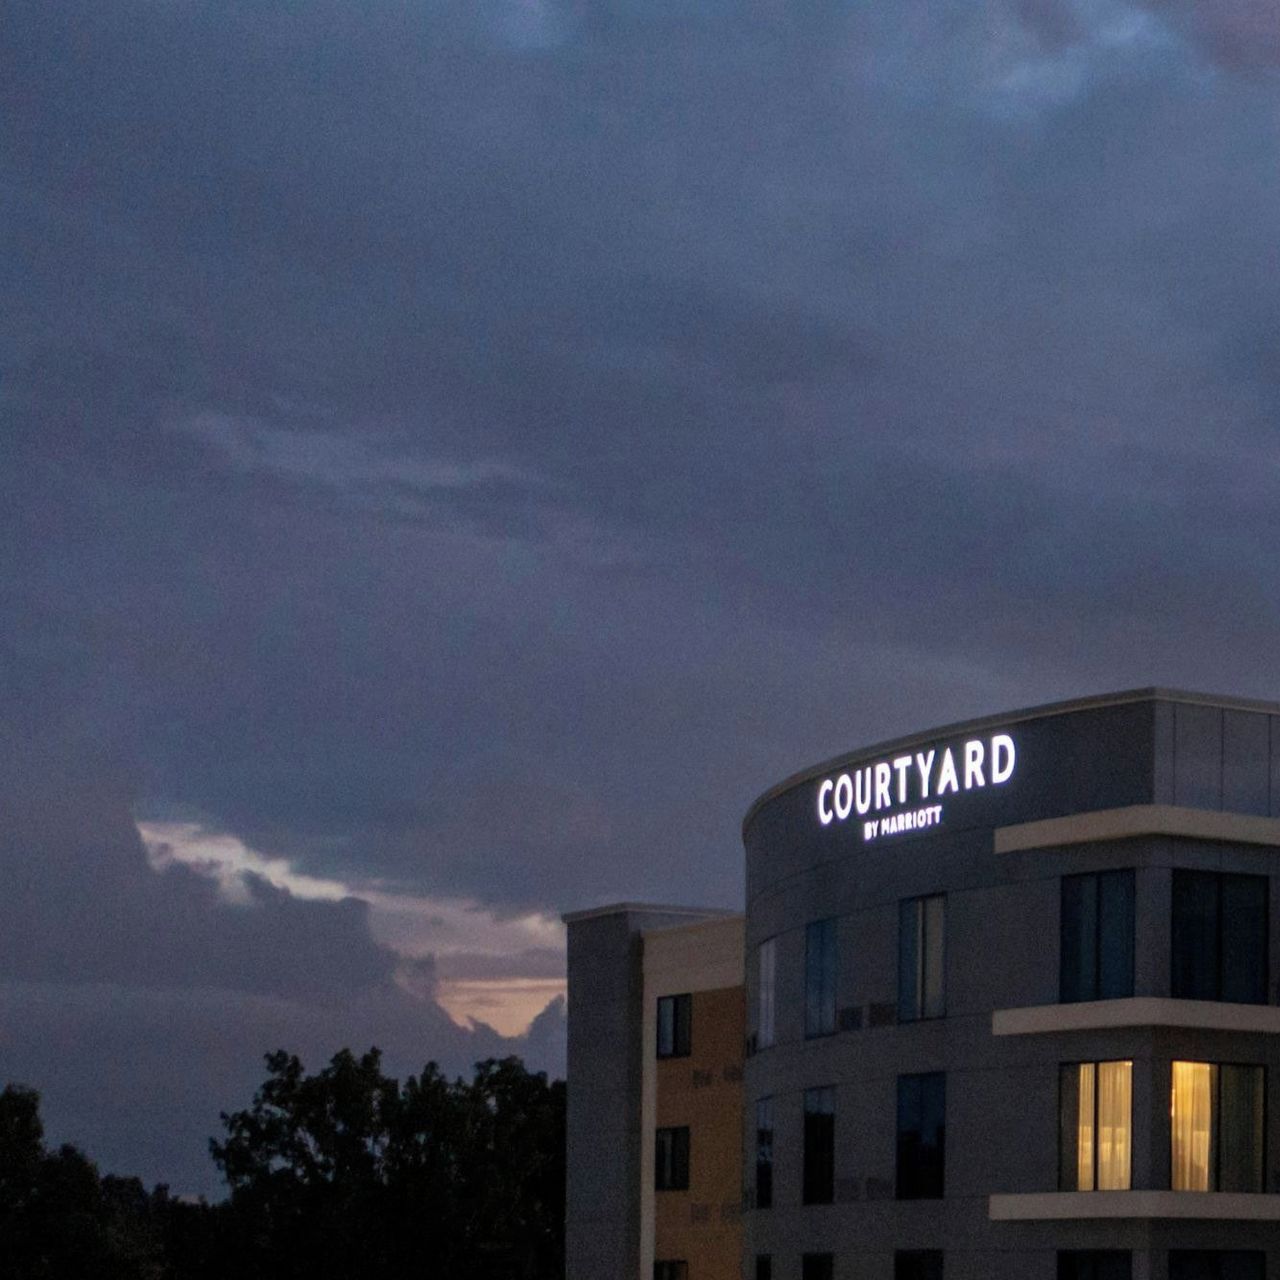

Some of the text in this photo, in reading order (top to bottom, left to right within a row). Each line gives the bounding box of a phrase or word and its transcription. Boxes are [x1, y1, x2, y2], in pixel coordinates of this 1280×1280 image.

[817, 734, 1016, 825] COURTYARD
[863, 805, 943, 841] BY MARRIOTT
